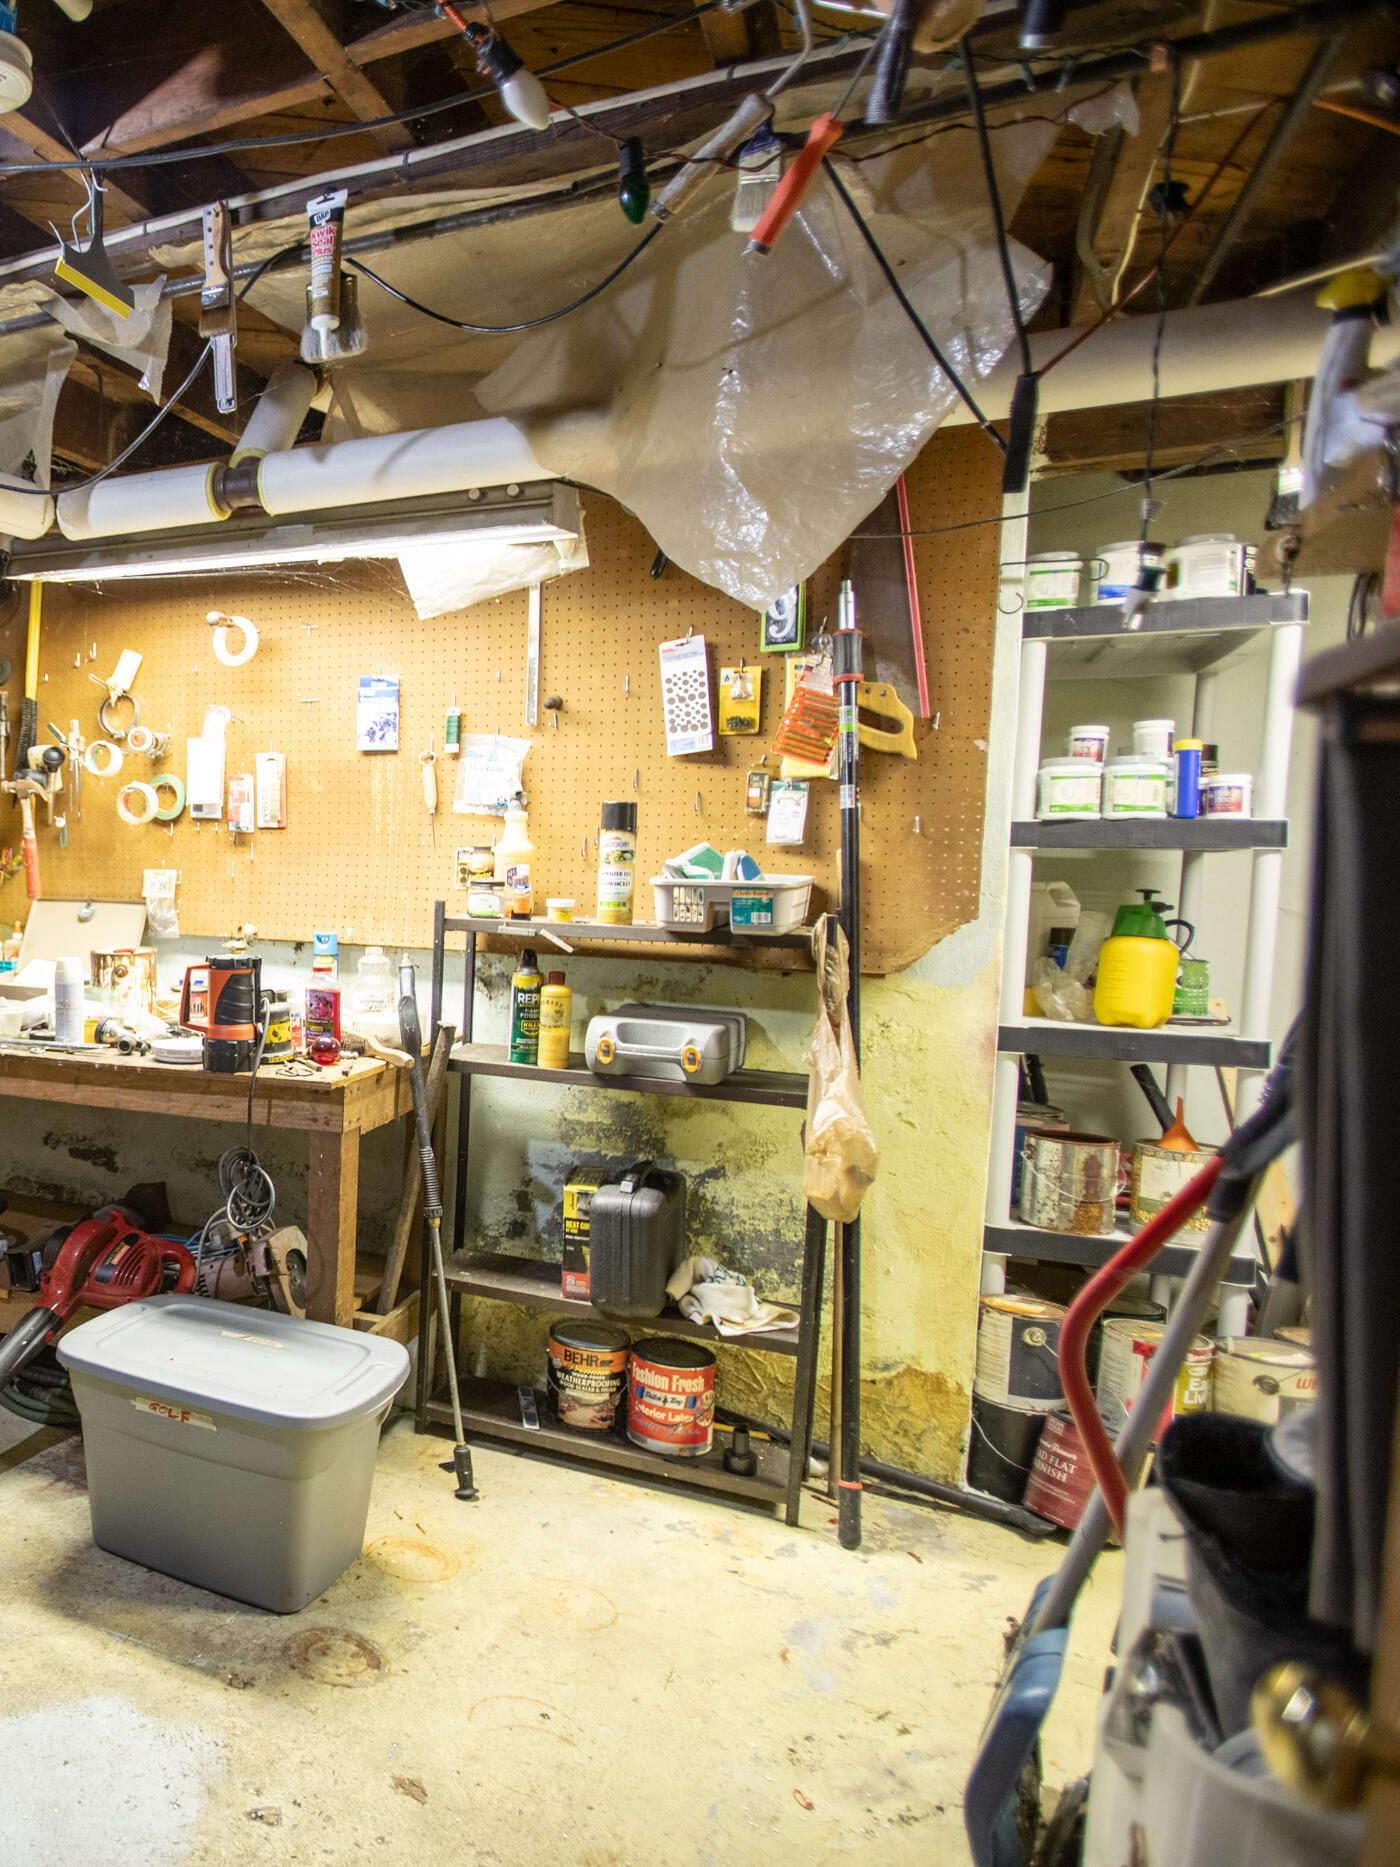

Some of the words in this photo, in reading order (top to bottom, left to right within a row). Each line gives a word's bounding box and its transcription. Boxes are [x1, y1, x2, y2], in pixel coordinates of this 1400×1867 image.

[518, 992, 540, 1004] REP
[564, 1348, 599, 1368] BEHR
[632, 1362, 669, 1391] Fashion
[672, 1374, 705, 1393] Fresh
[149, 1402, 191, 1424] GOLF
[1049, 1455, 1079, 1475] FLAT
